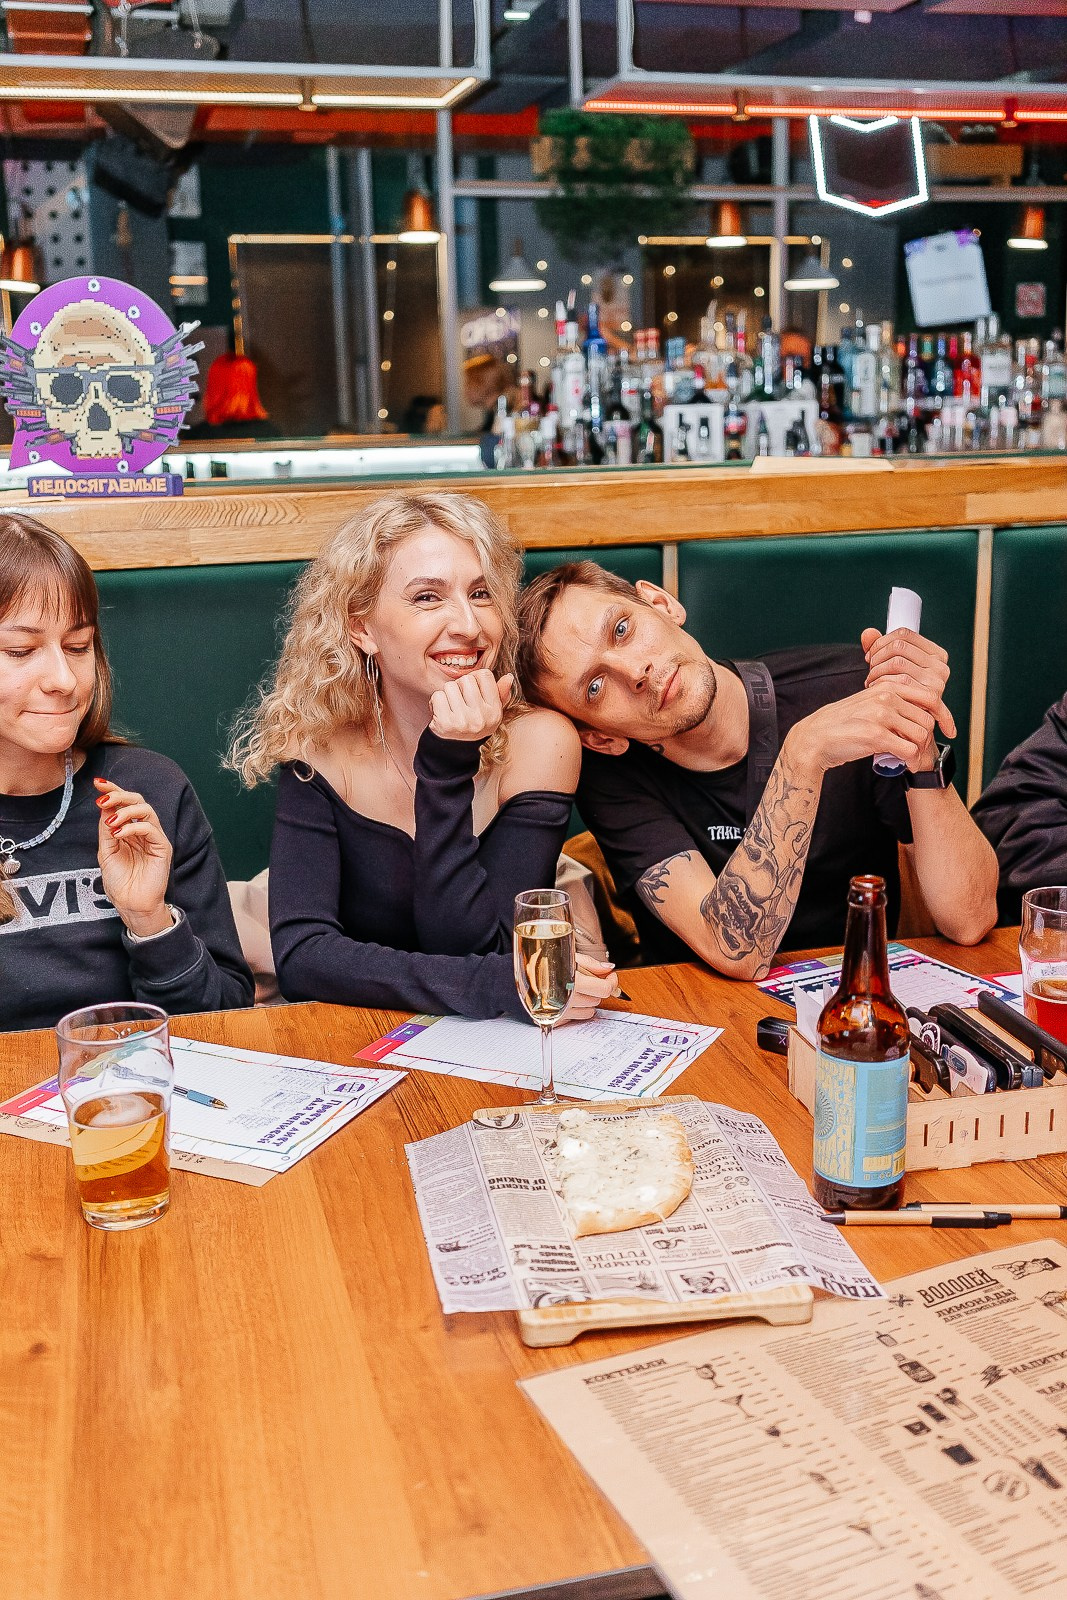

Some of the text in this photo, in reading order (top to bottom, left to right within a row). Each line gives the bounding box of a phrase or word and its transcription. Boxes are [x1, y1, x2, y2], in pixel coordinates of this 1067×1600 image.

[32, 477, 167, 495] НЕДОСЯГАЕМЫЕ
[707, 825, 742, 841] TAKE
[487, 1176, 530, 1185] BAKING
[488, 1183, 530, 1191] SECRETS
[582, 1250, 647, 1262] FUTURE
[821, 1276, 883, 1298] ITALY
[935, 1288, 1016, 1318] ЛИМОНАДЫ
[582, 1358, 667, 1385] КОКТЕЙЛИ
